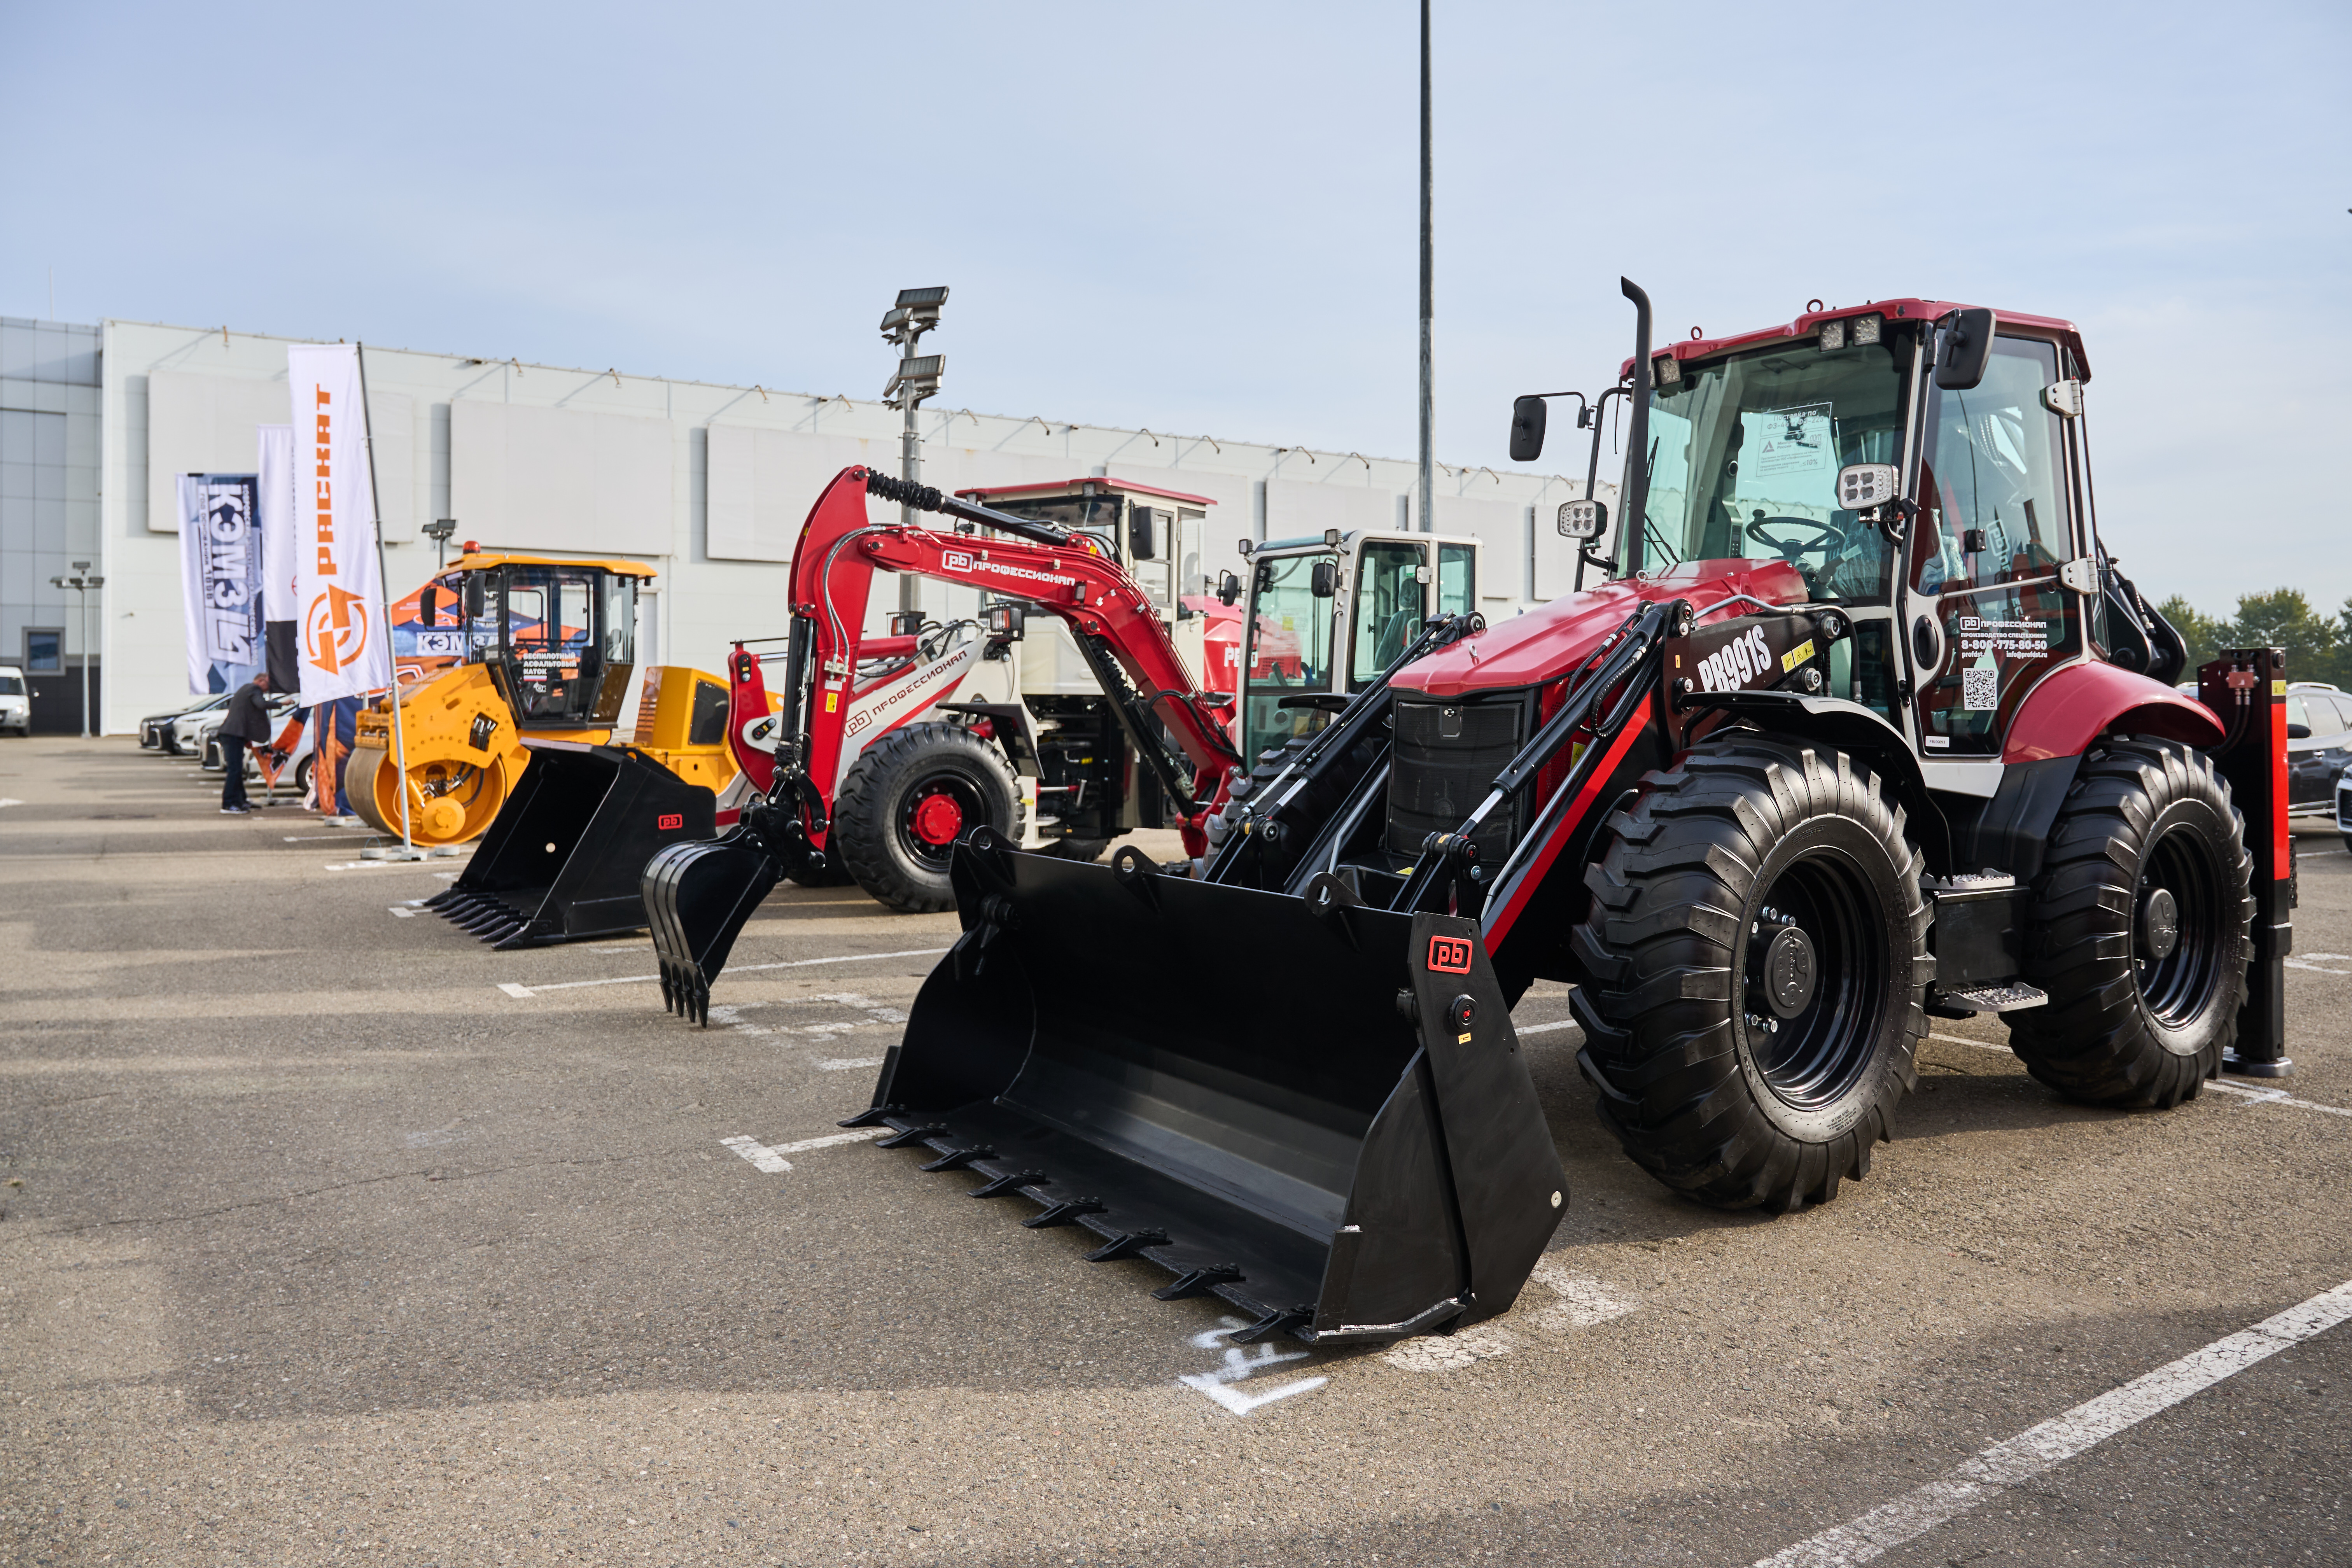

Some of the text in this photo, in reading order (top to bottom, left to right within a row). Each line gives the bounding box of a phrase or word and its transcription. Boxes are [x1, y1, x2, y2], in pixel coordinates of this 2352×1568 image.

[1774, 411, 1806, 421] Поставка
[1797, 416, 1824, 425] ФЗ-223
[317, 383, 337, 575] РАСКАТ
[208, 484, 249, 608] КЭМЗ
[1961, 640, 2047, 649] 8-800-775-80-50
[523, 652, 576, 660] БЕСПИЛОТНЫЙ
[1698, 625, 1771, 692] PB991S
[2006, 651, 2048, 659] info@profdst.ru
[1883, 1039, 1900, 1074] HEAVY
[1871, 1073, 1886, 1097] DUTY
